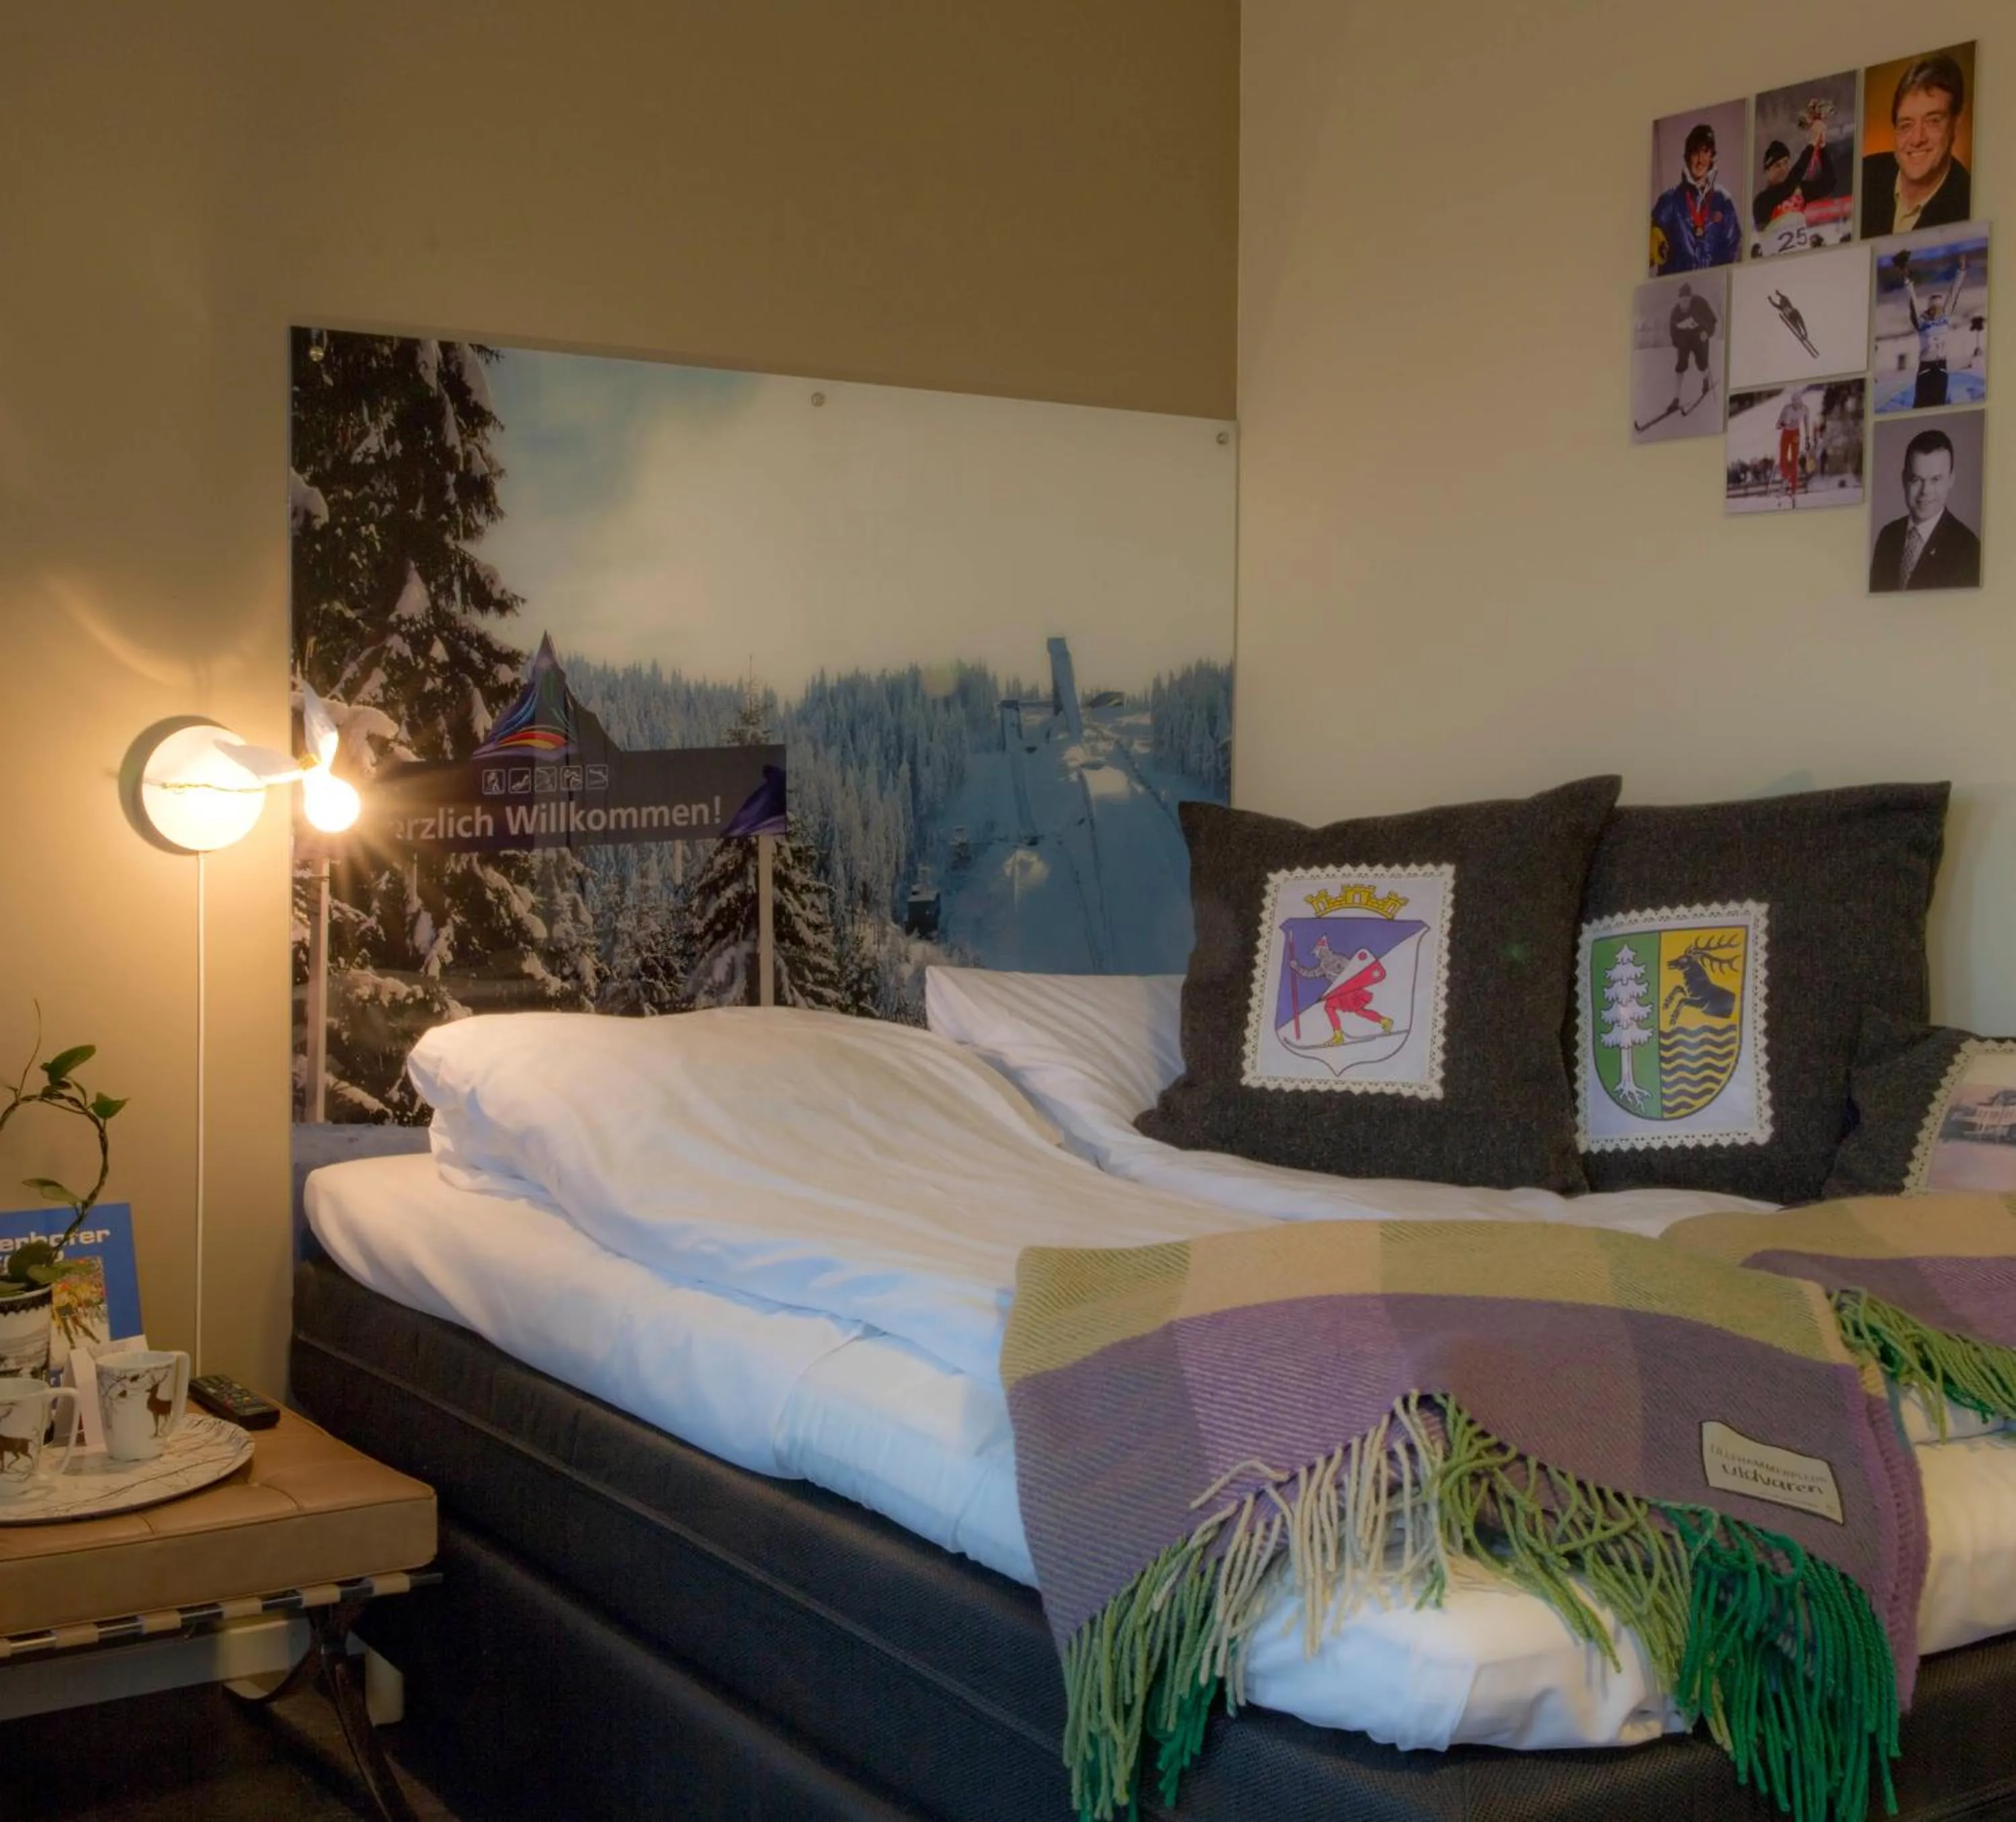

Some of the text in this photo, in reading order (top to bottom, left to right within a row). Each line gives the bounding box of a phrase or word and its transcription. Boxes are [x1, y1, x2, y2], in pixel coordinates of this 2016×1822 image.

[1777, 227, 1808, 252] 25
[389, 795, 721, 840] erzlich Willkommen!
